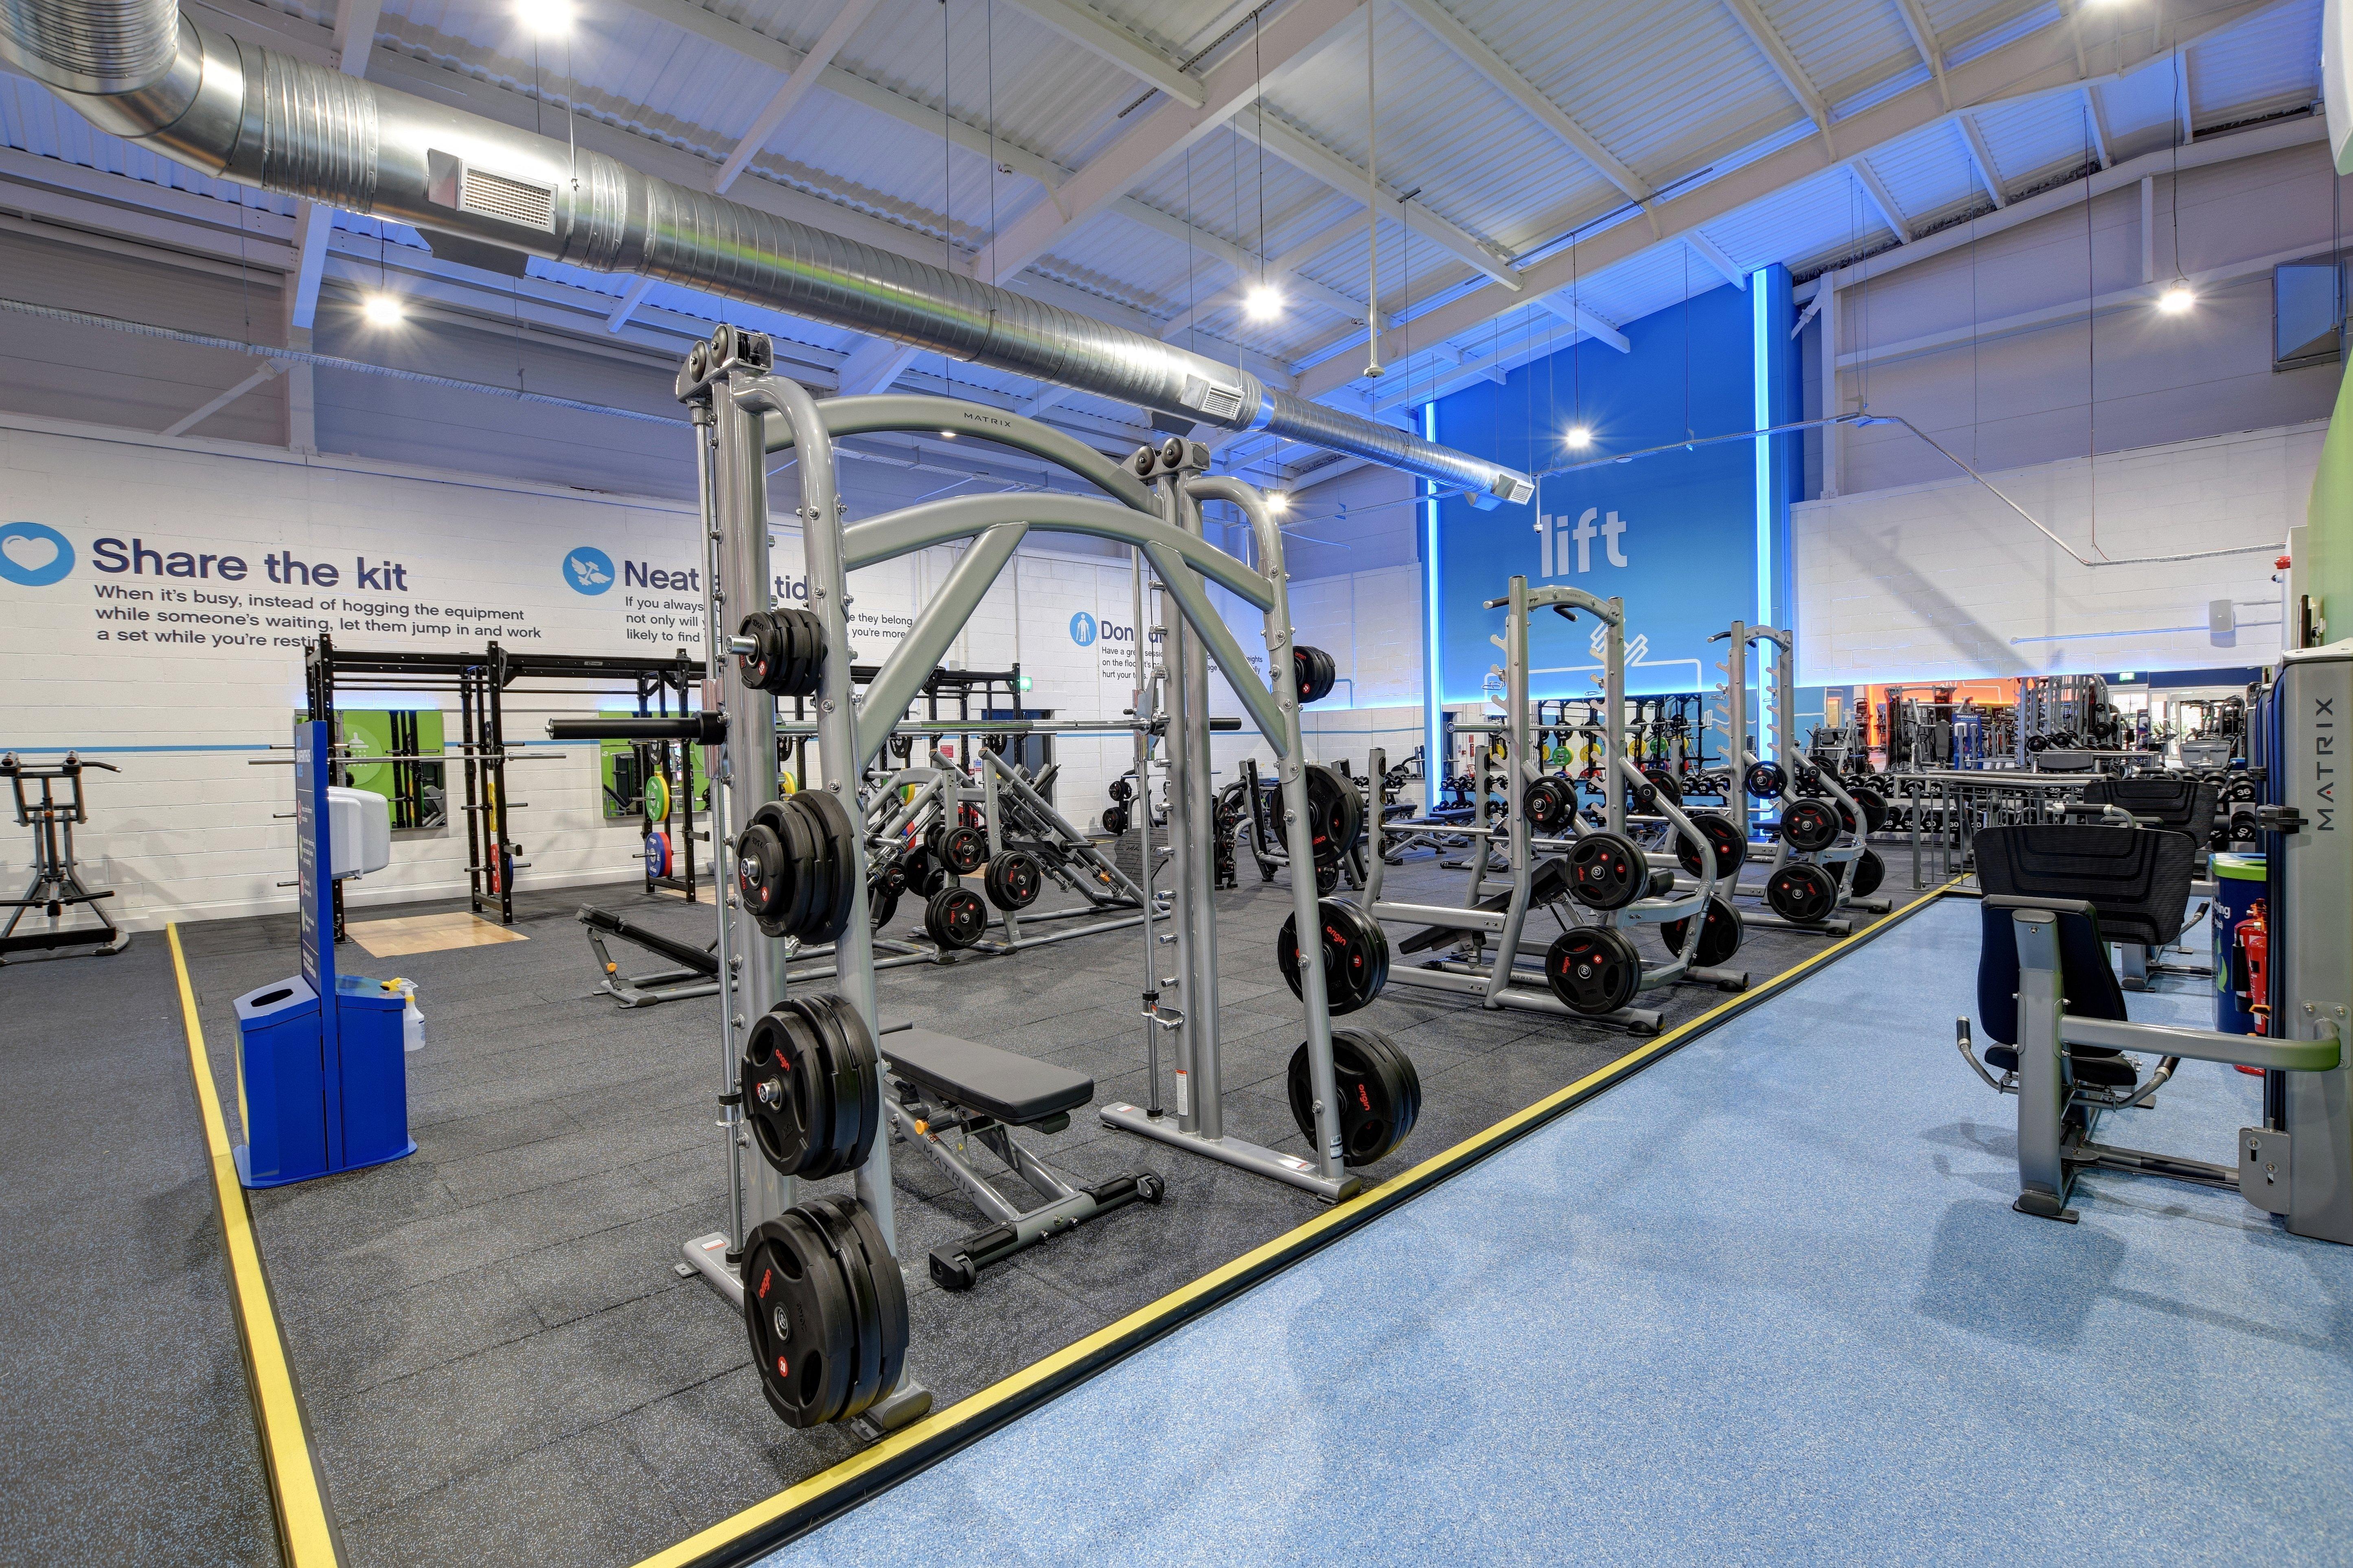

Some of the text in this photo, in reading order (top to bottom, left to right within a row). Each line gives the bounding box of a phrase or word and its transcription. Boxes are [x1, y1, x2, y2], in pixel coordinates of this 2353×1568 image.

[964, 412, 1011, 427] MATRIX
[1541, 507, 1628, 578] lift
[92, 537, 408, 591] Share the kit
[625, 560, 700, 591] Neat
[775, 575, 808, 600] tid
[94, 585, 524, 621] When it's busy, instead of hogging the equipment
[625, 596, 704, 613] If you always
[95, 606, 542, 638] while someone's waiting, let them jump in and work
[626, 614, 646, 624] not
[650, 615, 675, 628] only
[679, 616, 698, 626] will
[858, 613, 879, 625] they
[881, 614, 913, 627] belong
[97, 629, 337, 648] a set while you're restin.
[627, 628, 658, 643] likely
[662, 631, 673, 641] to
[677, 631, 700, 642] find
[852, 628, 906, 638] you're more
[1101, 620, 1134, 642] Don
[1102, 646, 1118, 655] Have
[1246, 655, 1262, 664] eights
[1112, 658, 1123, 666] the
[1125, 659, 1136, 667] floo
[1102, 669, 1115, 678] hurt
[1117, 672, 1131, 680] your
[2315, 697, 2334, 831] MATRIX
[902, 809, 920, 827] MATRIX
[1327, 926, 1347, 946] origin
[1562, 956, 1570, 974] origin
[775, 1049, 790, 1072] origin
[1358, 1084, 1370, 1111] origin
[759, 1269, 772, 1298] origin
[780, 1360, 787, 1373] 20
